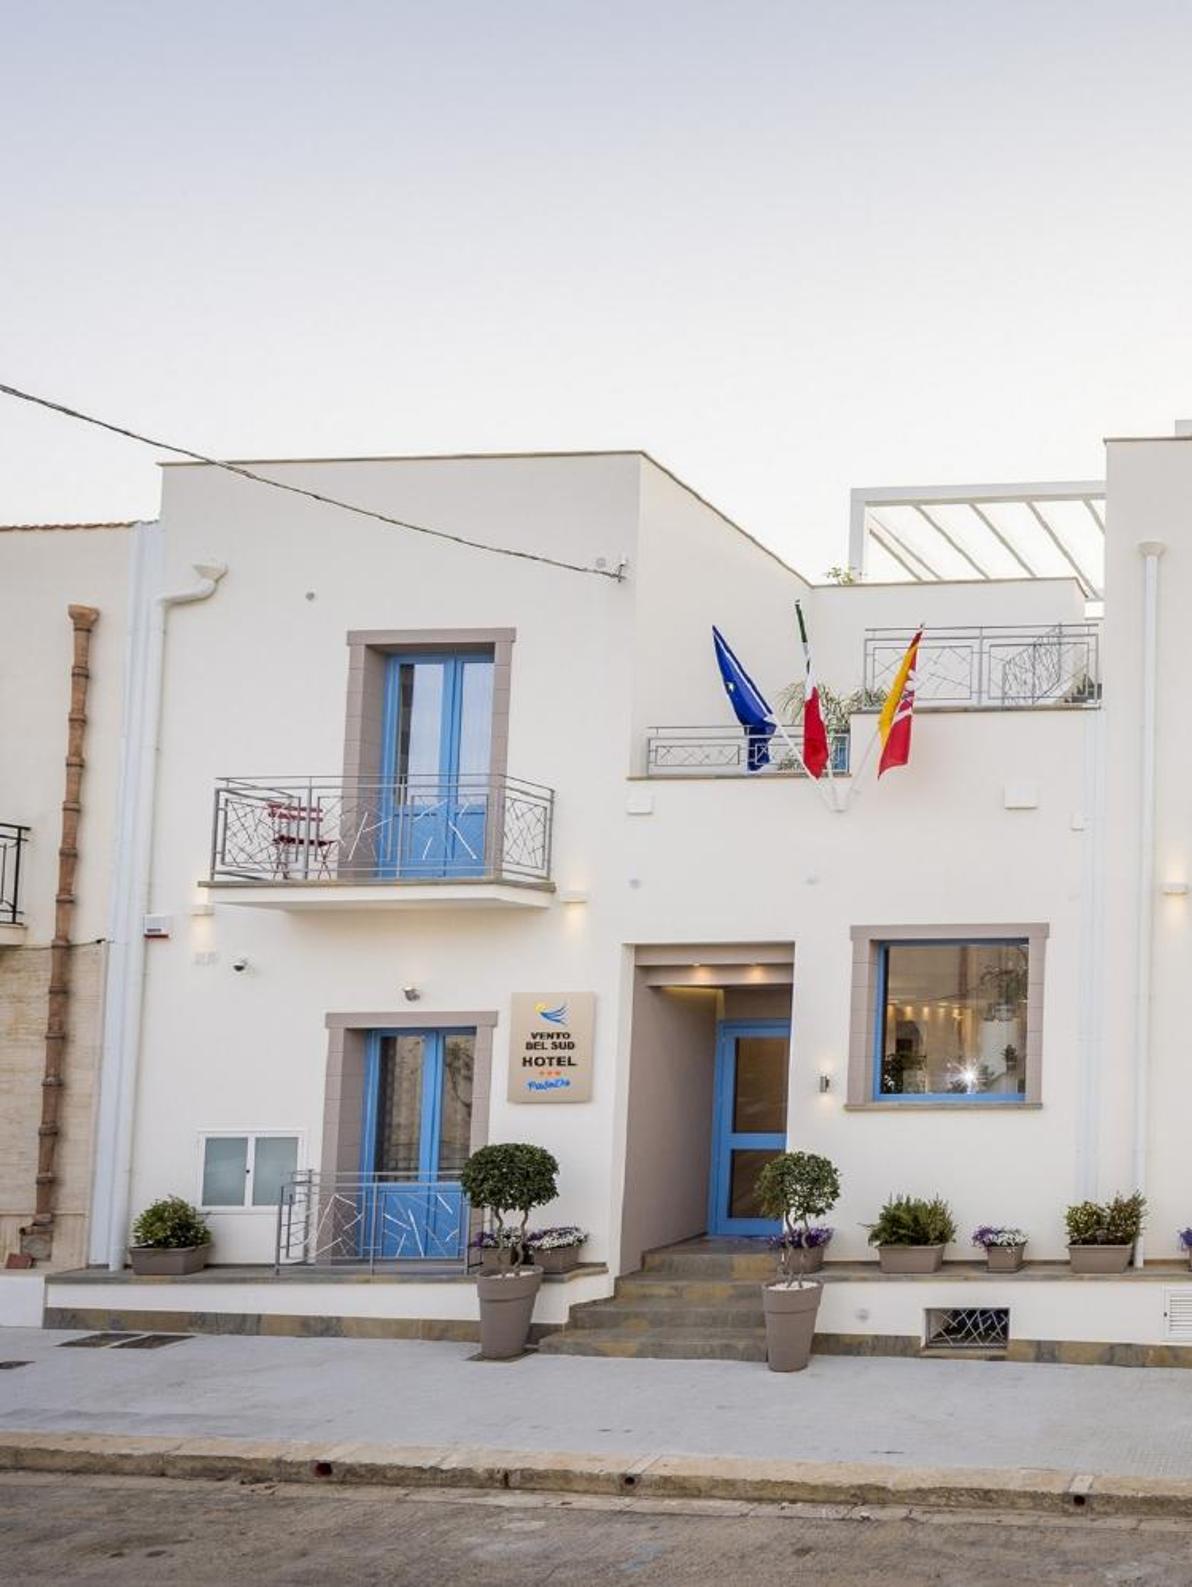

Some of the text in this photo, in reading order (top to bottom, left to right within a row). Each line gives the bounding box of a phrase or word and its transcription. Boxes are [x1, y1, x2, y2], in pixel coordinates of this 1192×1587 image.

[530, 1031, 571, 1040] VENTO
[551, 1041, 575, 1050] SUD
[522, 1056, 578, 1067] HOTEL
